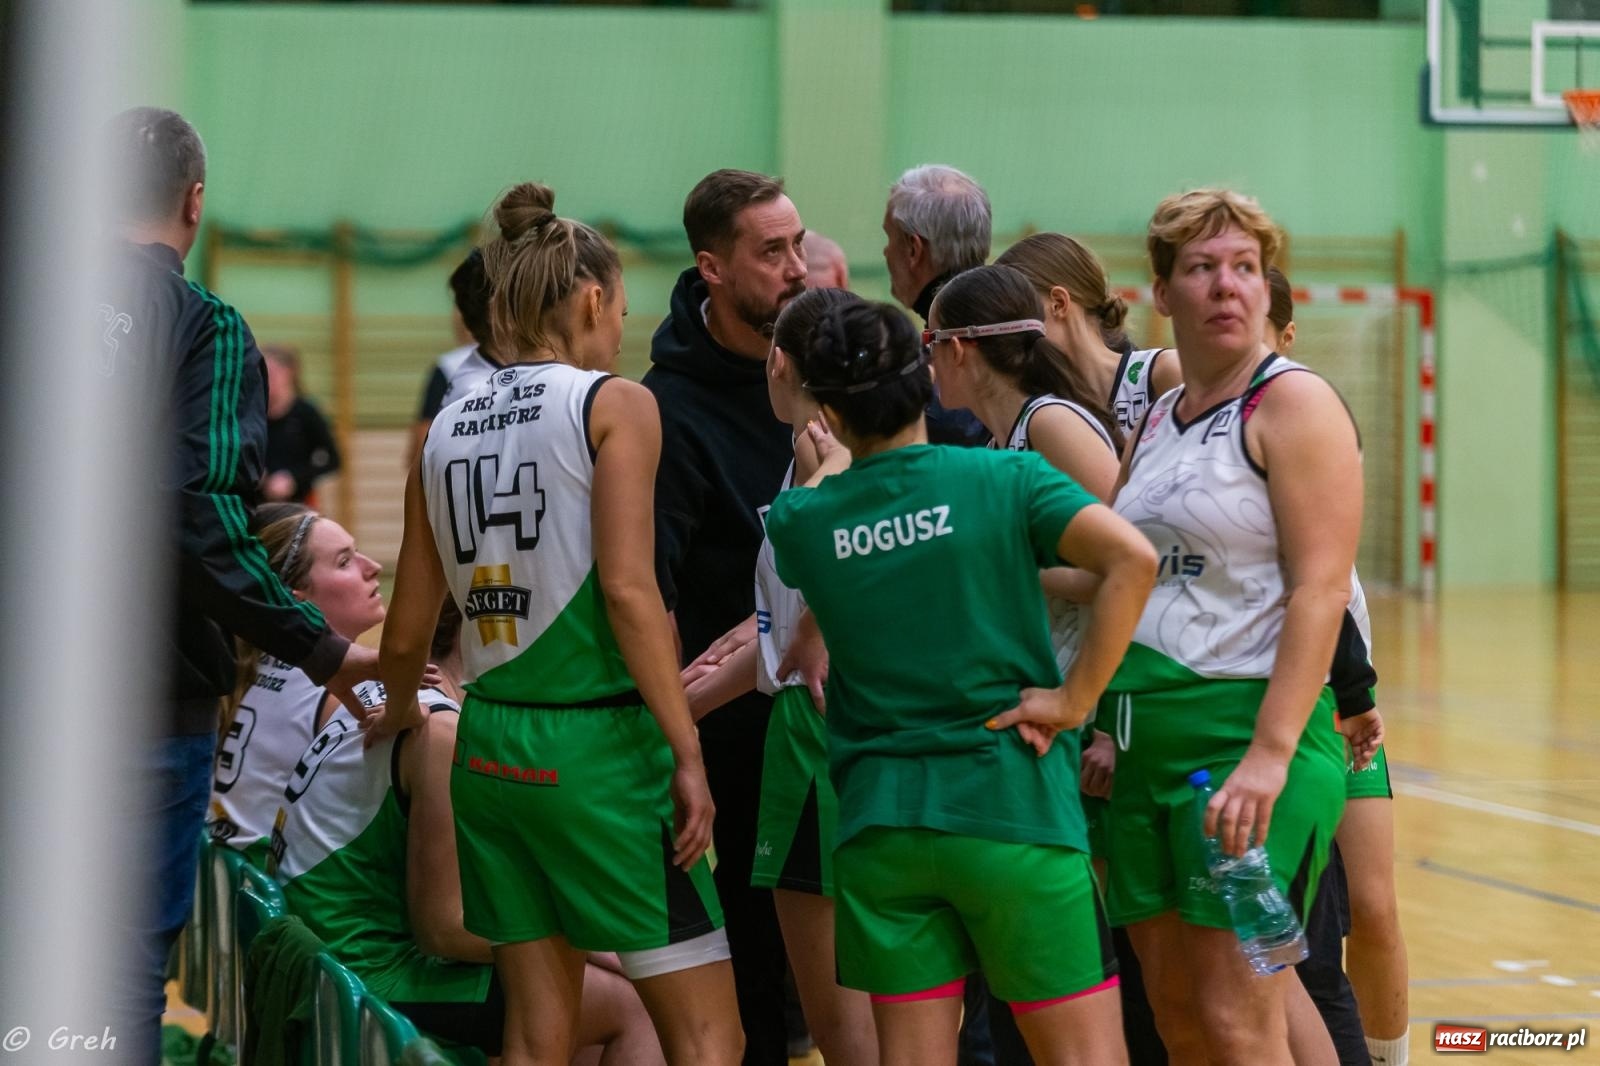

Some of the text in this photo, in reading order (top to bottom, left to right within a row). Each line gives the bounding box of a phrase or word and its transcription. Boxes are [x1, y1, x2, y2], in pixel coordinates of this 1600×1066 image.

[445, 454, 546, 564] 14
[833, 504, 953, 560] BOGUSZ
[465, 591, 526, 614] SEGET
[469, 756, 559, 785] KAMAN
